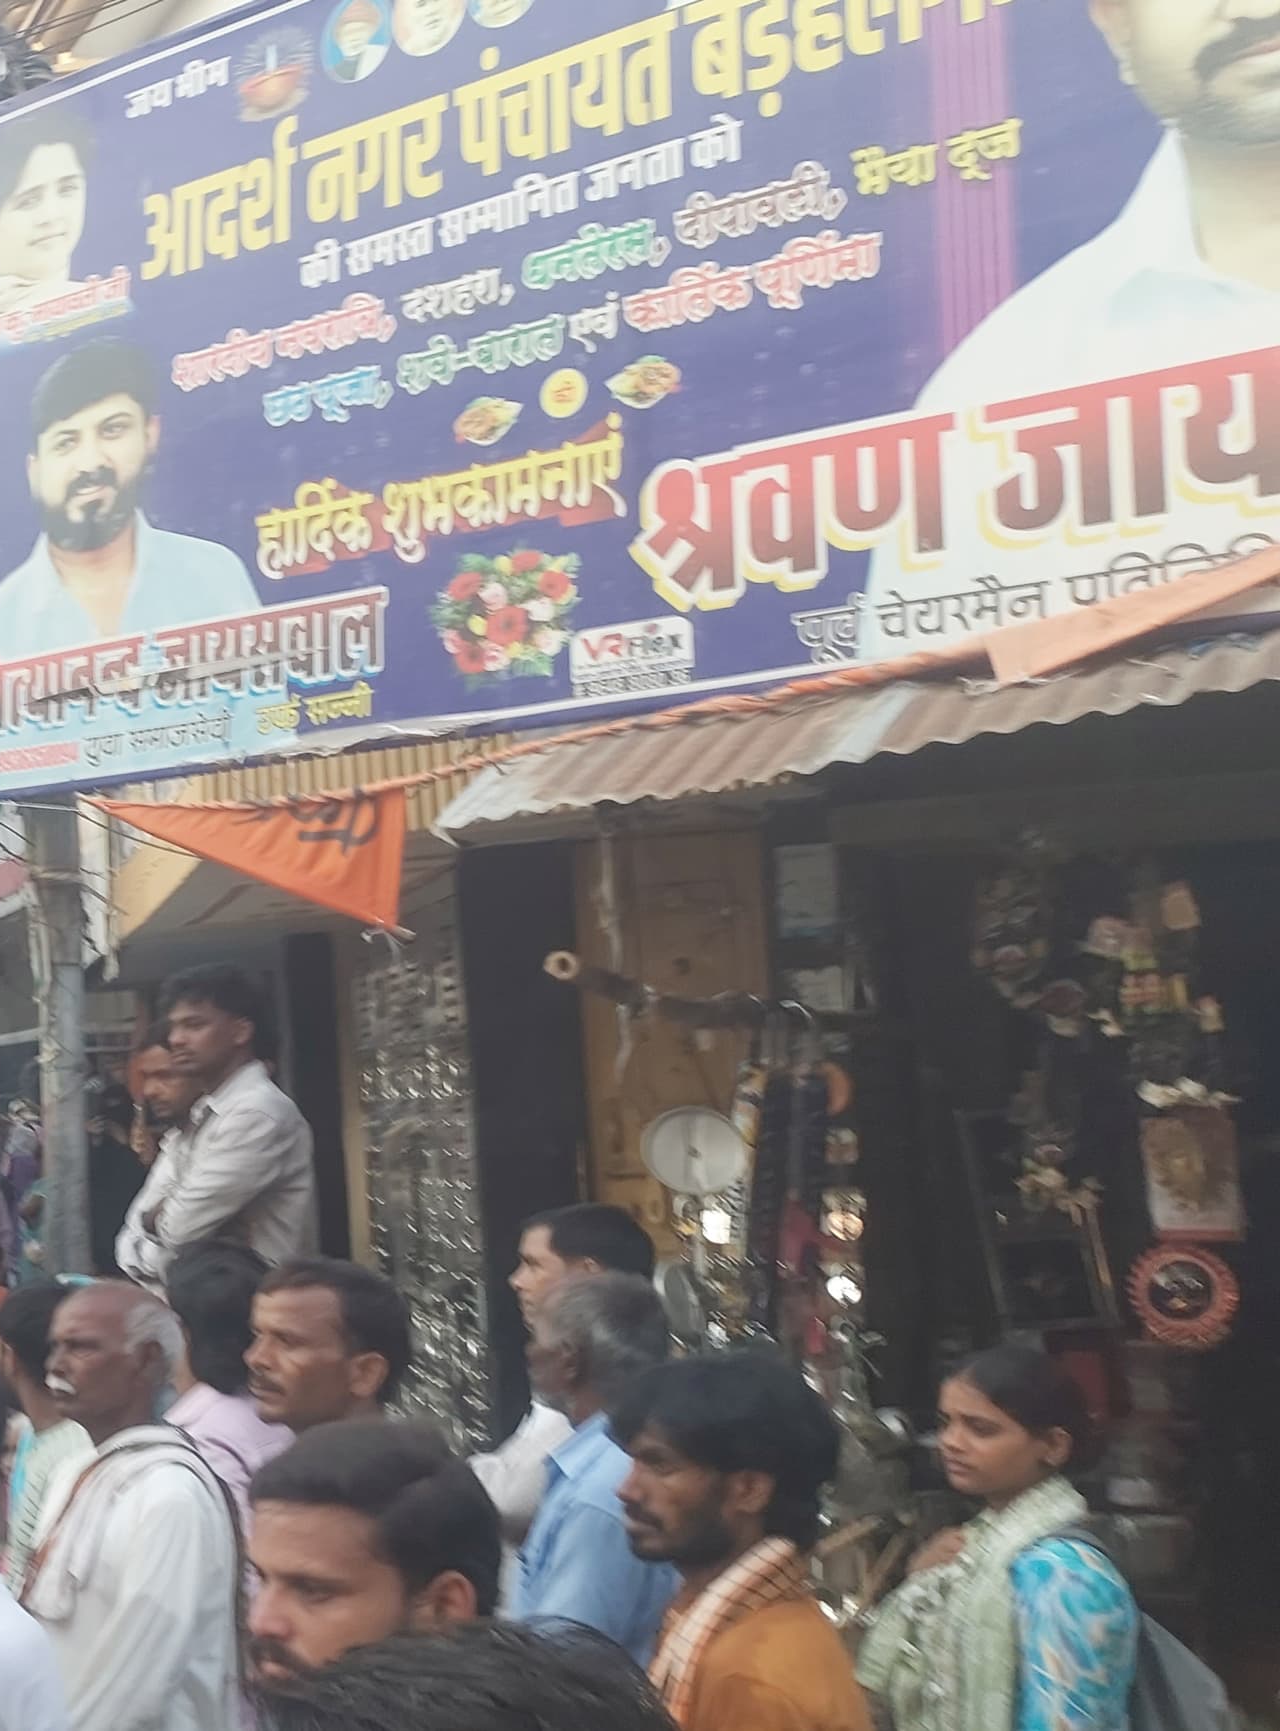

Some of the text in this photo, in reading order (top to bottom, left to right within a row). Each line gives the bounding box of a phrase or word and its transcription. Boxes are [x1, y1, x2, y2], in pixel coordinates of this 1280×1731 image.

[141, 116, 298, 281] आदर्श
[302, 92, 449, 225] नगर
[453, 8, 678, 176] पंचायत
[946, 117, 1023, 181] दूज
[298, 113, 744, 287] की समस्त सम्मानित जनता को
[567, 291, 620, 353] एवं
[256, 477, 376, 578] हार्दिक
[632, 410, 957, 610] श्रवण
[791, 592, 864, 663] पूर्व
[875, 576, 1052, 639] चेयरमैन
